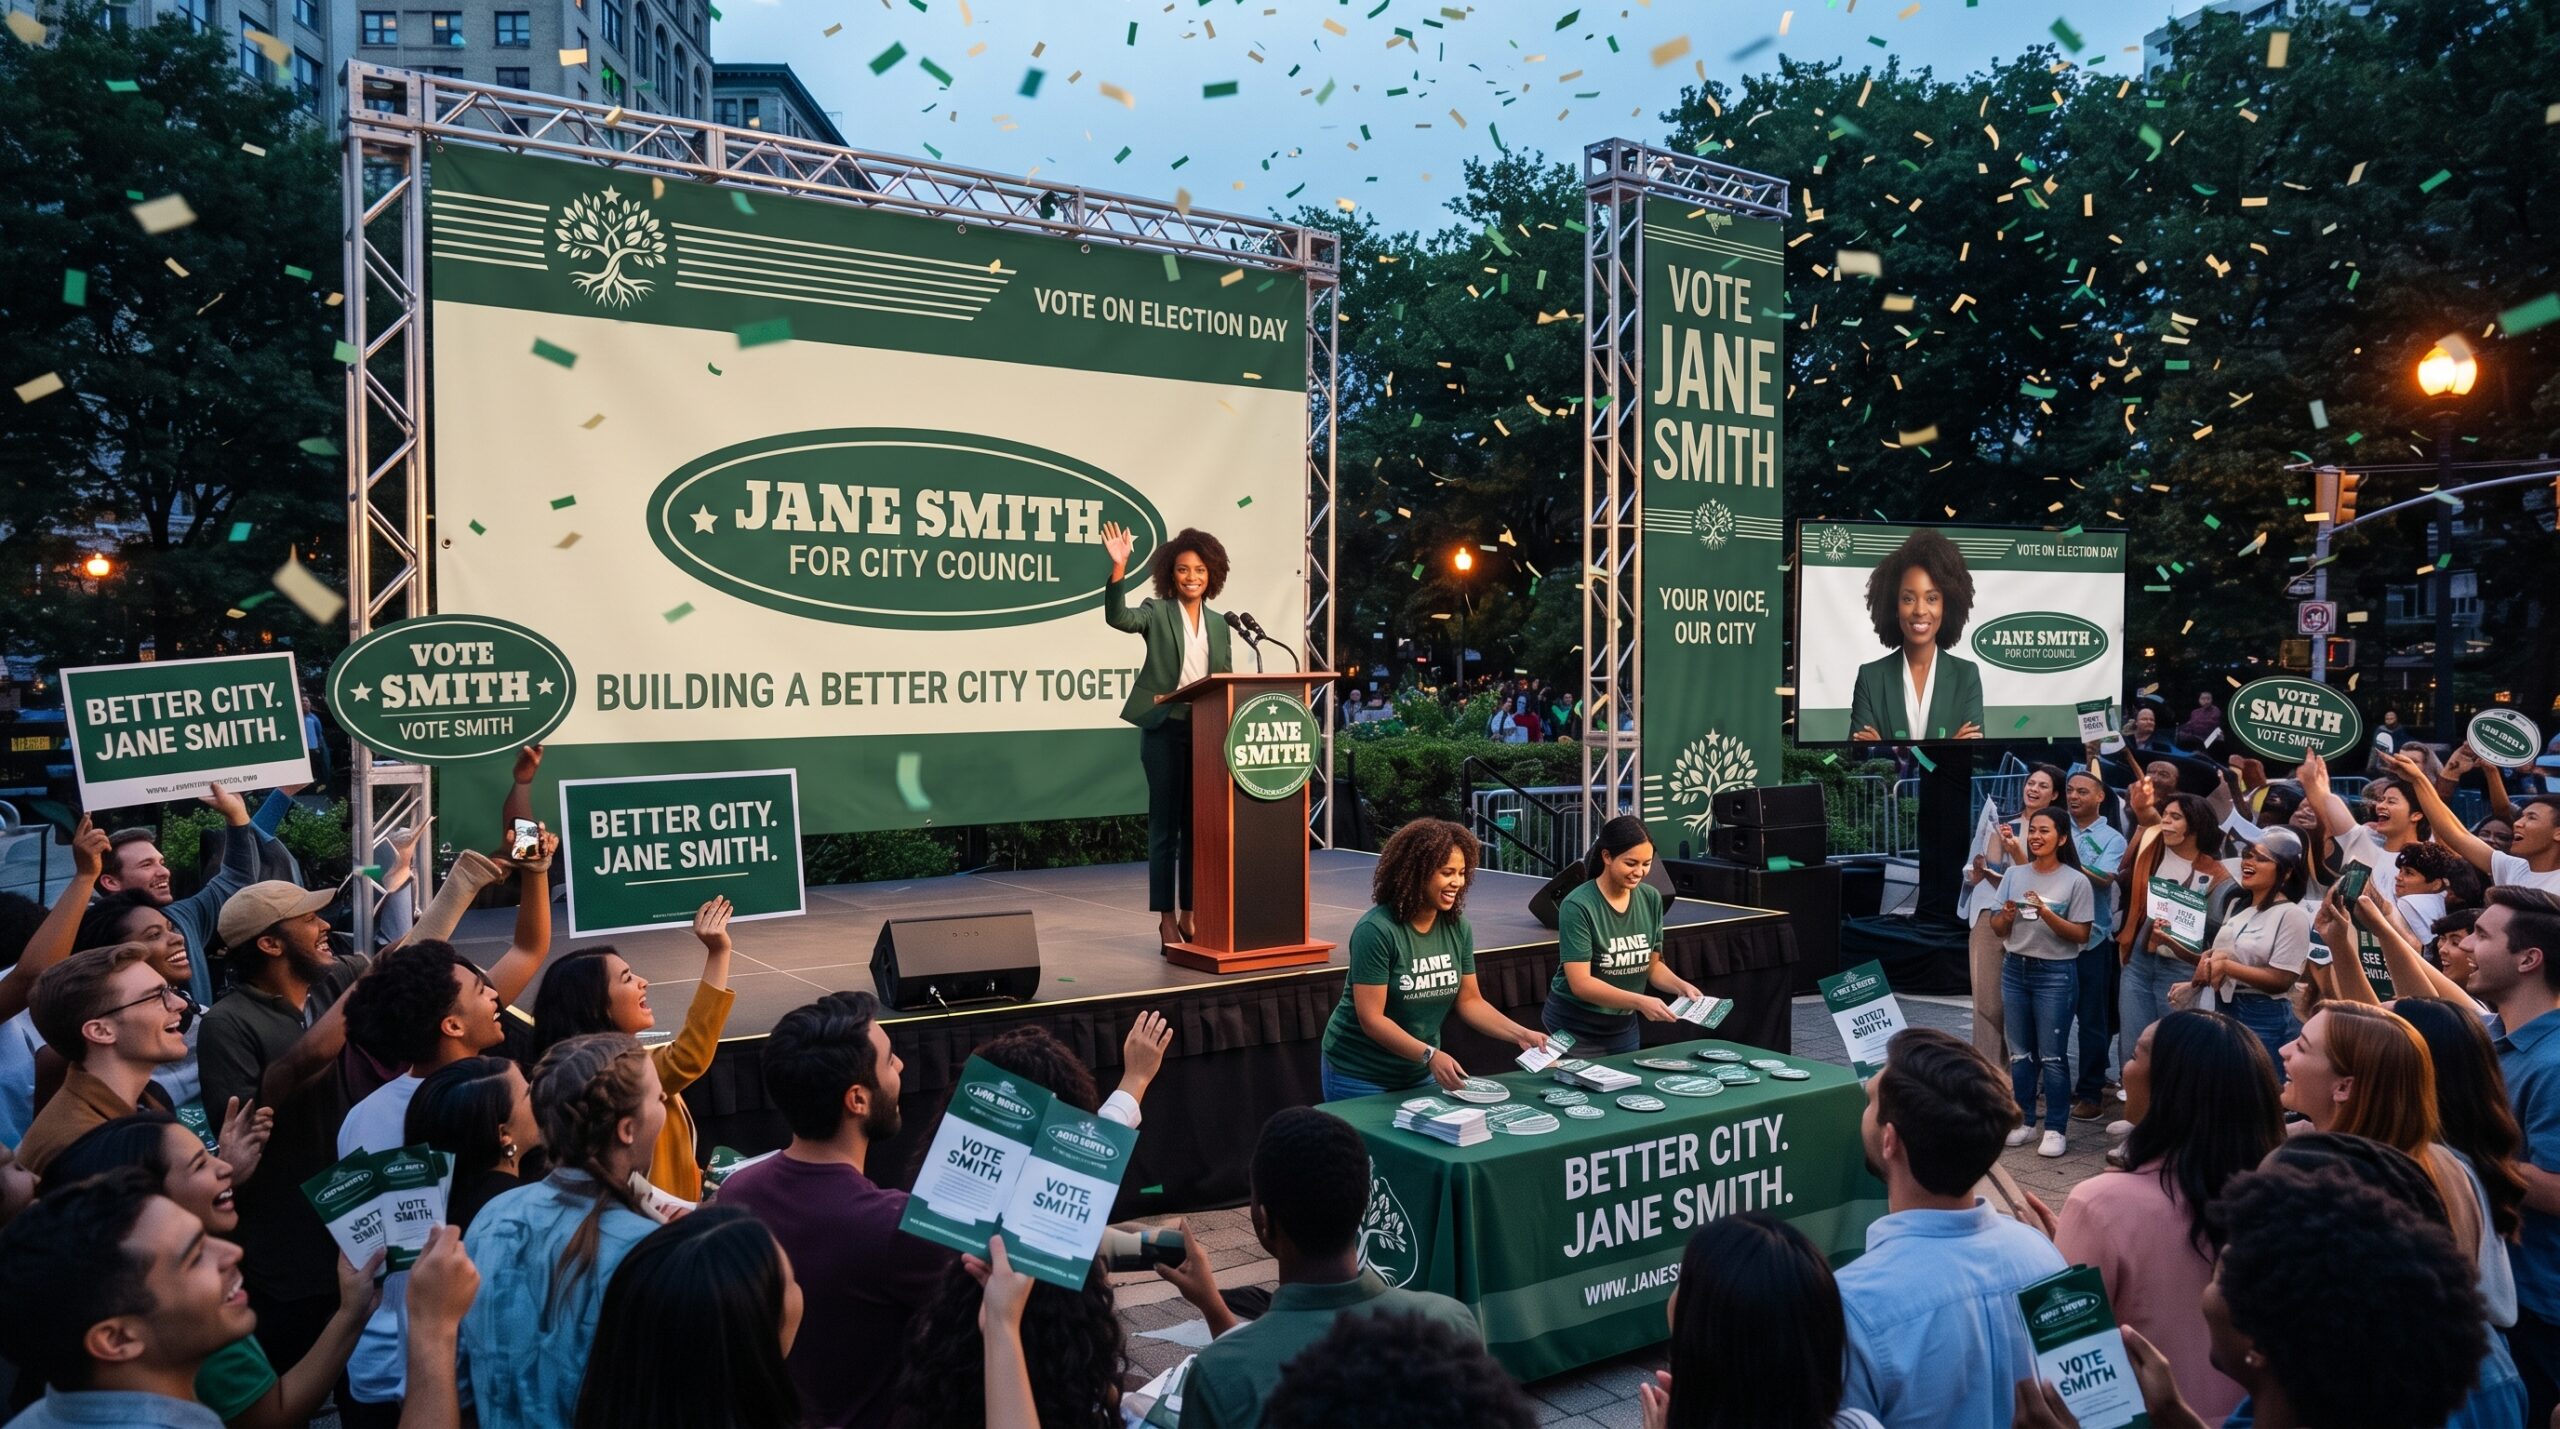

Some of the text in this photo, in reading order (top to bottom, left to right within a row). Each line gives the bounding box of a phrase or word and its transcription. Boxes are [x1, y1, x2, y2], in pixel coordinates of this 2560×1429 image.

[1668, 264, 1752, 324] VOTE
[1034, 287, 1288, 342] VOTE ON ELECTION DAY
[1654, 324, 1775, 418] JANE
[1653, 417, 1774, 488] SMITH
[736, 479, 1104, 544] JANE SMITH
[790, 544, 1060, 582] FOR CITY COUNCIL
[2017, 543, 2118, 558] VOTE ON ELECTION DAY
[1659, 587, 1769, 617] YOUR VOICE,
[1675, 621, 1756, 644] OUR CITY
[1992, 630, 2090, 646] JANE SMITH
[410, 641, 494, 667] VOTE
[2022, 649, 2041, 659] CITY
[2042, 649, 2076, 659] COUNCIL
[86, 682, 283, 726] BETTER CITY.
[380, 671, 530, 708] SMITH
[597, 668, 1138, 711] BUILDING A BETTER CITY TOGET
[2277, 688, 2320, 706] VOTE
[400, 717, 513, 740] VOTE SMITH
[1245, 722, 1301, 742] JANE
[2250, 698, 2343, 734] SMITH
[96, 716, 286, 761] JANE SMITH.
[2256, 728, 2286, 743] VOTE
[1234, 743, 1311, 766] SMITH
[590, 800, 777, 839] BETTER CITY.
[594, 835, 778, 875] JANE SMITH.
[1608, 934, 1649, 953] JANE
[1411, 954, 1452, 973] JANE
[962, 1135, 1005, 1165] VOTE
[1565, 1113, 1788, 1201] BETTER CITY.
[947, 1150, 1002, 1183] SMITH
[398, 1199, 427, 1212] VOTE
[1046, 1177, 1091, 1205] VOTE
[394, 1208, 433, 1223] SMITH
[1033, 1192, 1091, 1224] SMITH
[1563, 1165, 1794, 1258] JANE SMITH.
[1584, 1262, 1682, 1306] WWW.JANES
[2058, 1349, 2106, 1375] VOTE
[2059, 1364, 2117, 1397] SMITH
